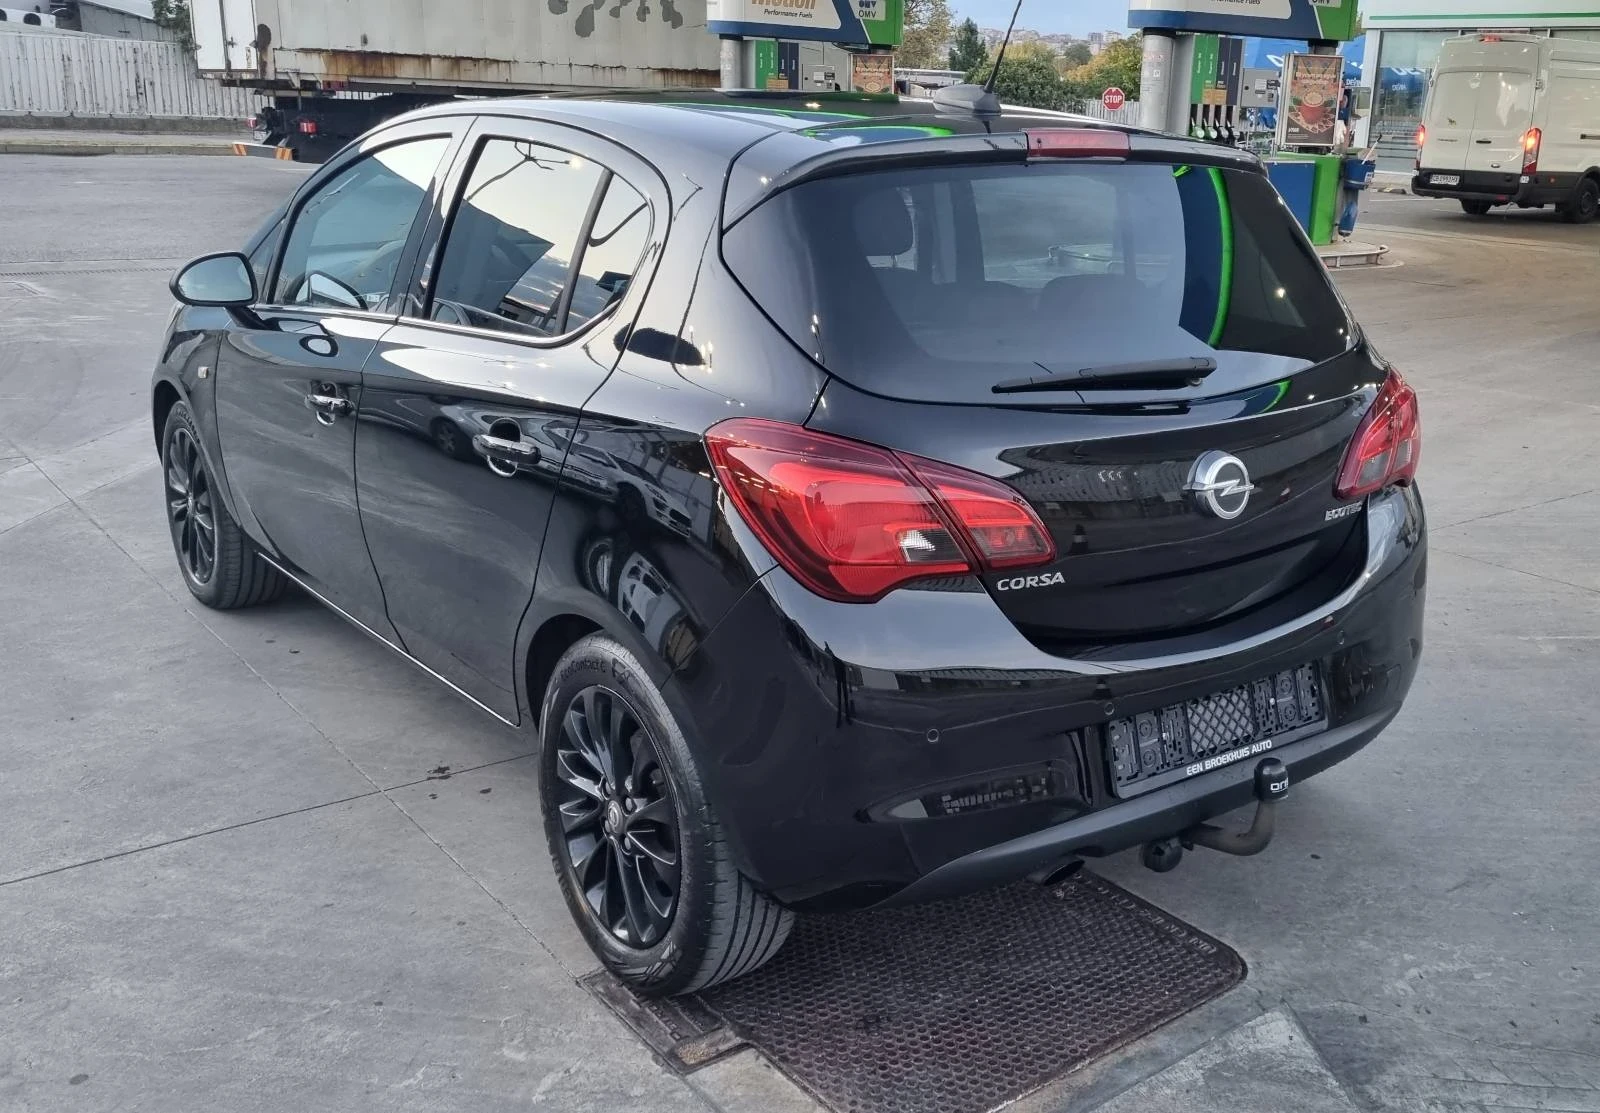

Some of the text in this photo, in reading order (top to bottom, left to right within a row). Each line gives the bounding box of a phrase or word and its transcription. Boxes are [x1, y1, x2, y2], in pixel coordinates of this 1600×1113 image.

[764, 8, 813, 19] Performance Fuels
[858, 9, 877, 18] OMV
[1104, 95, 1123, 104] STOP
[997, 571, 1065, 591] CORSA
[1186, 739, 1273, 775] EEN BROEKHUIS AUTO
